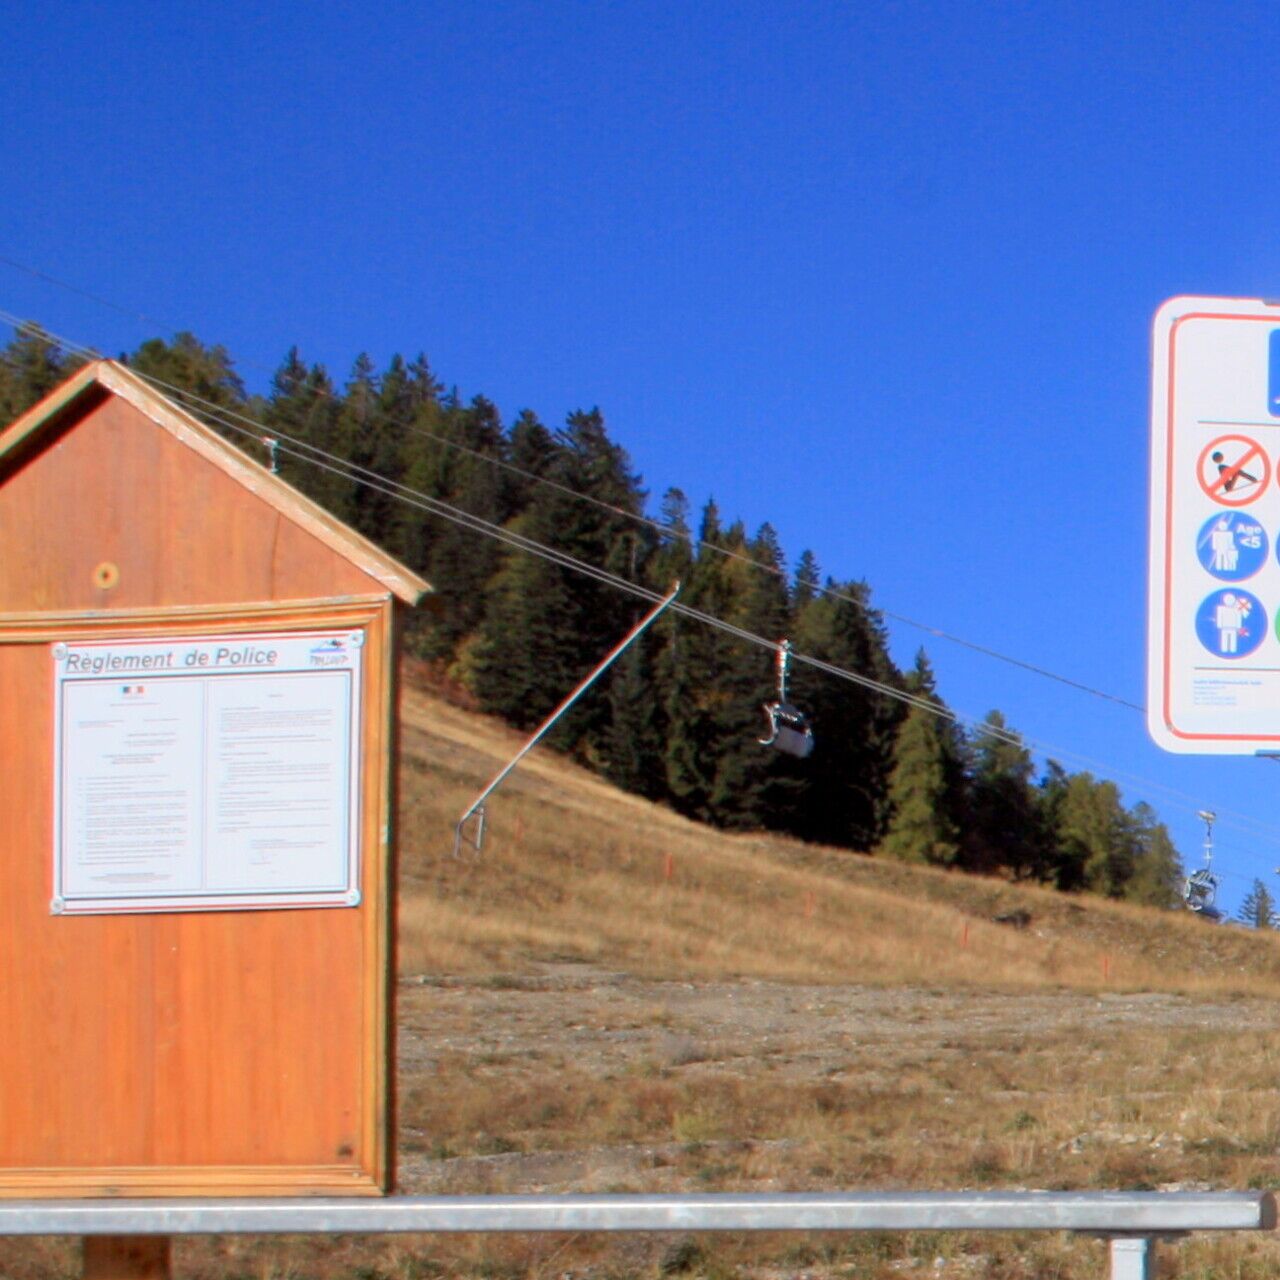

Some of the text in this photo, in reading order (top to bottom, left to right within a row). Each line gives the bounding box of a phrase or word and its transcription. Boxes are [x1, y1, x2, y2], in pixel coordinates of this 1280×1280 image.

[1237, 523, 1262, 535] Age
[65, 647, 278, 674] Règlement de Police
